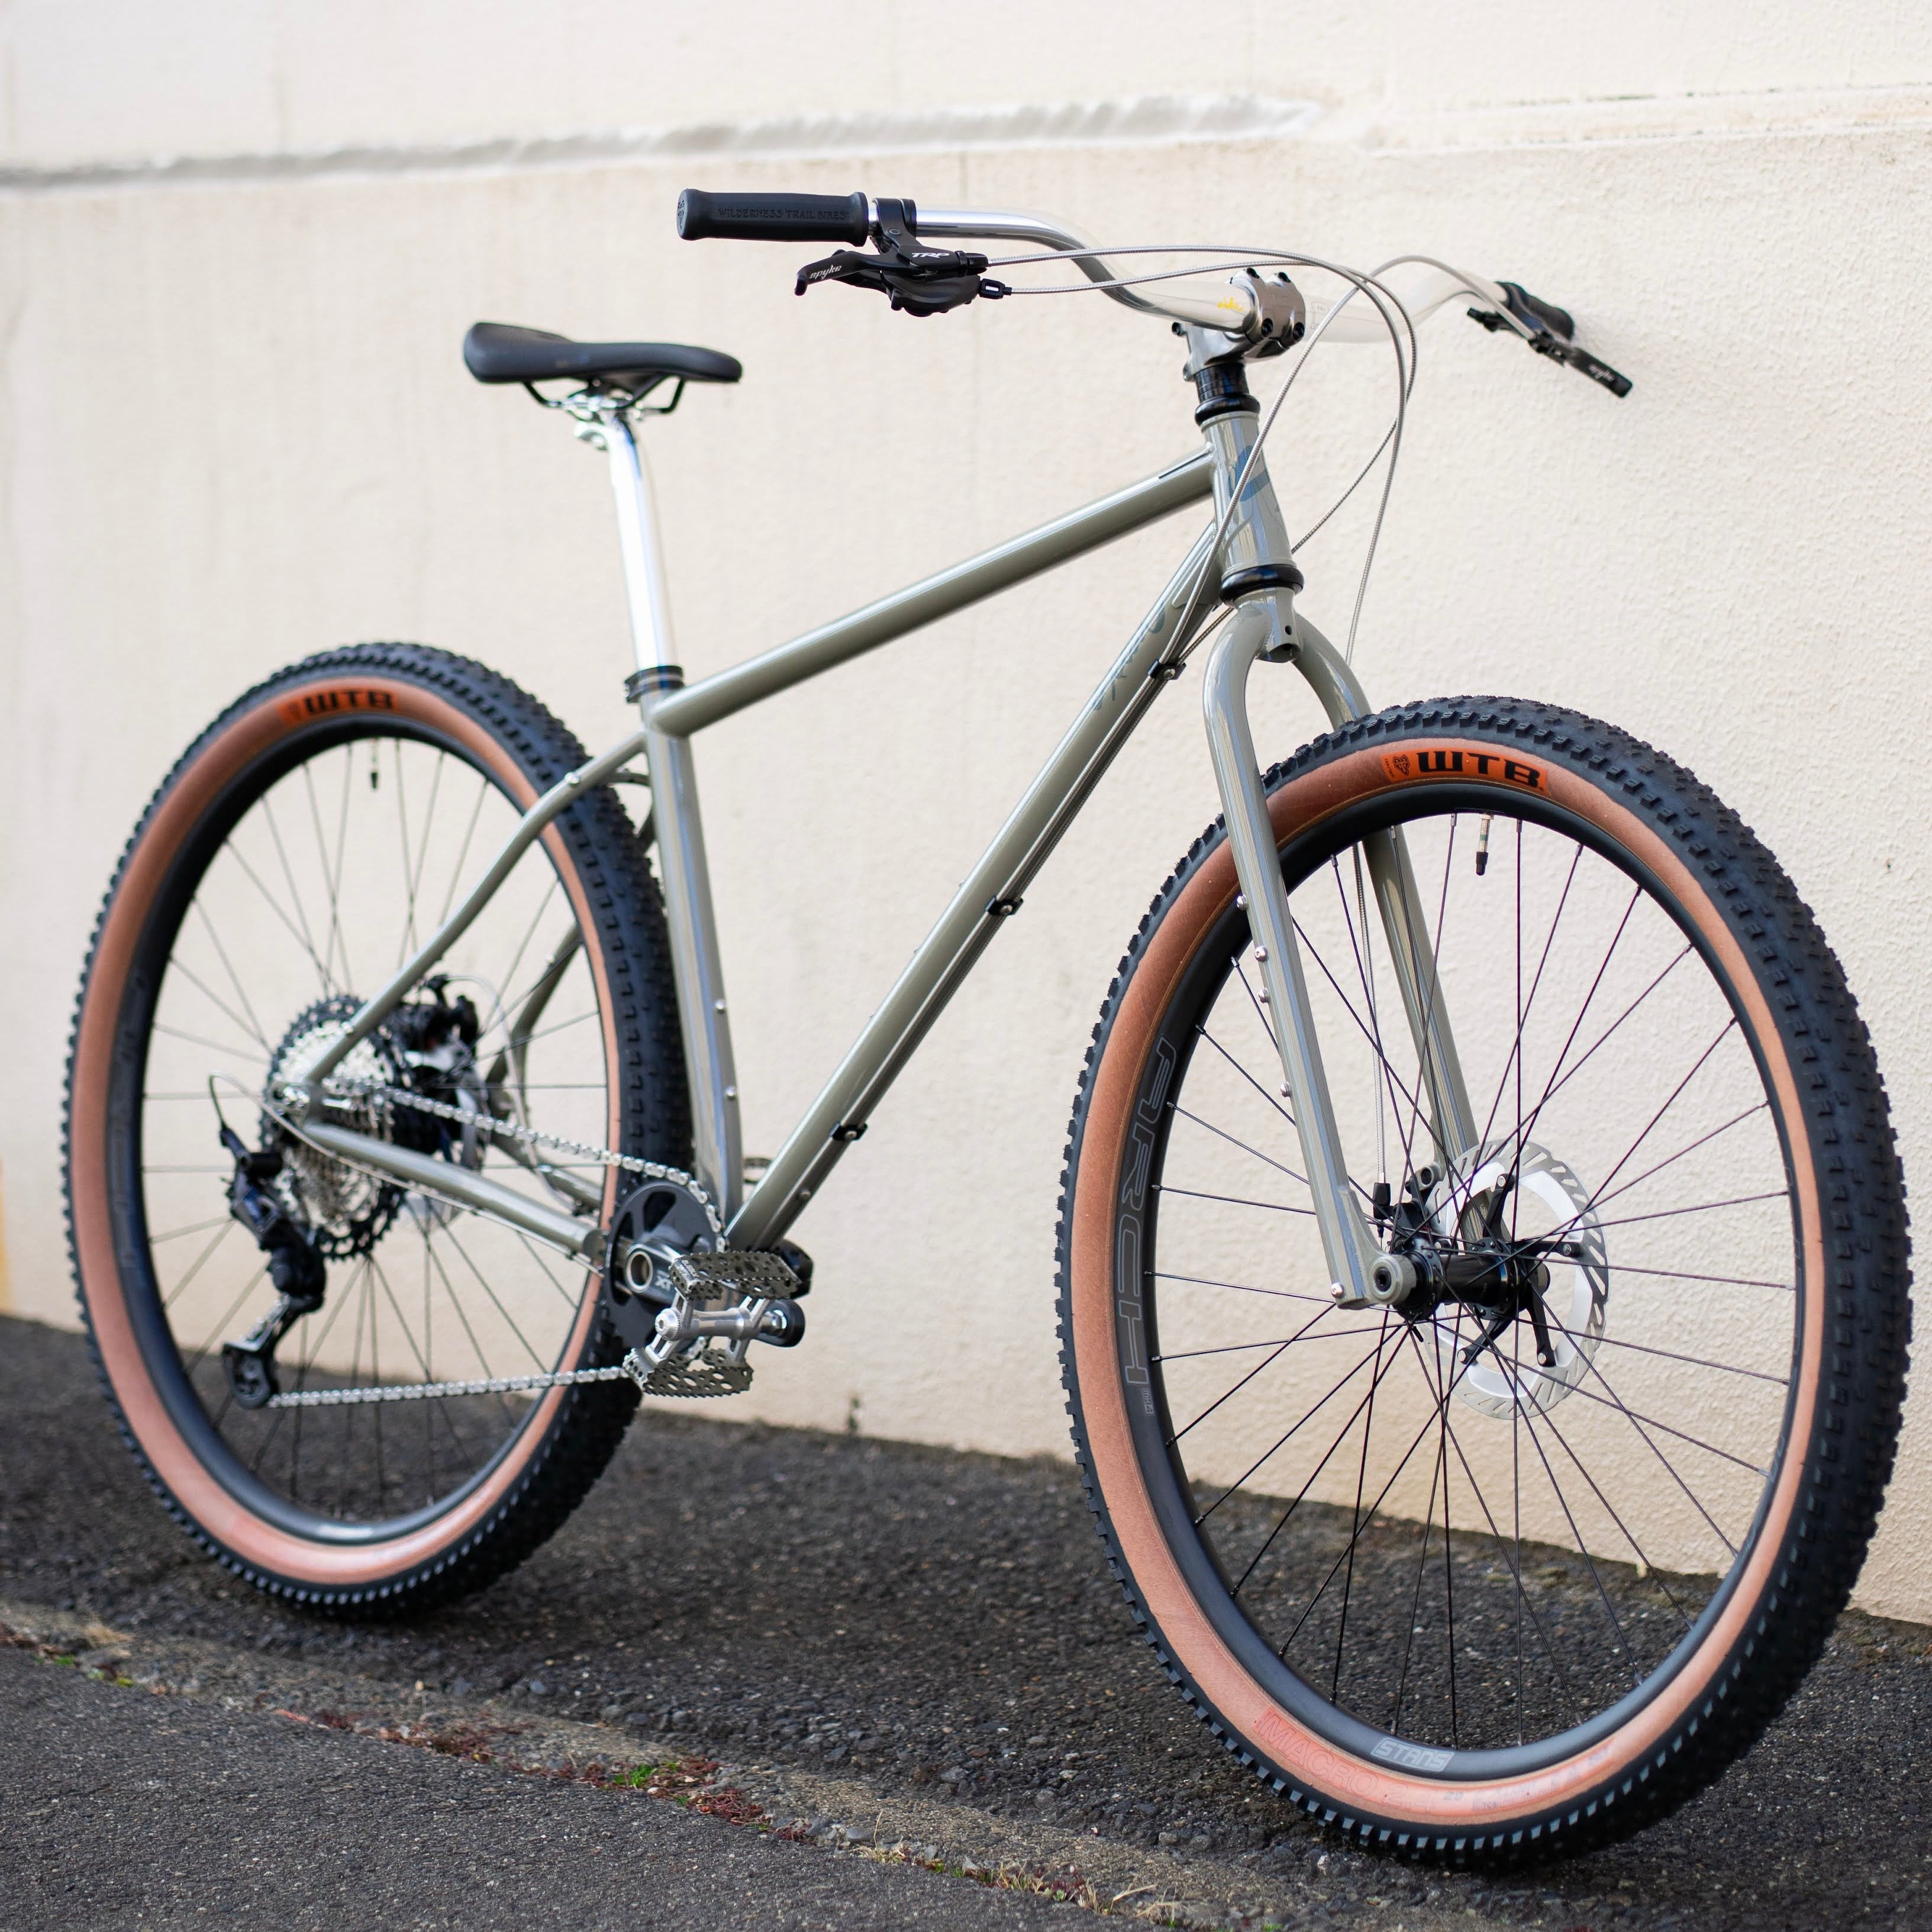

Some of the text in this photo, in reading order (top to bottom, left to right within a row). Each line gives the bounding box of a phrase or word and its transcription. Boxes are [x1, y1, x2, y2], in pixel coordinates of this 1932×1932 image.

[717, 208, 848, 221] WILDERNESS TRAIL BIKES
[809, 265, 842, 280] spyke
[304, 690, 394, 714] WTB
[1415, 750, 1541, 789] WTB
[1116, 1037, 1177, 1385] ARCH
[1257, 1712, 1378, 1796] MACRO
[1375, 1740, 1451, 1770] STANS
